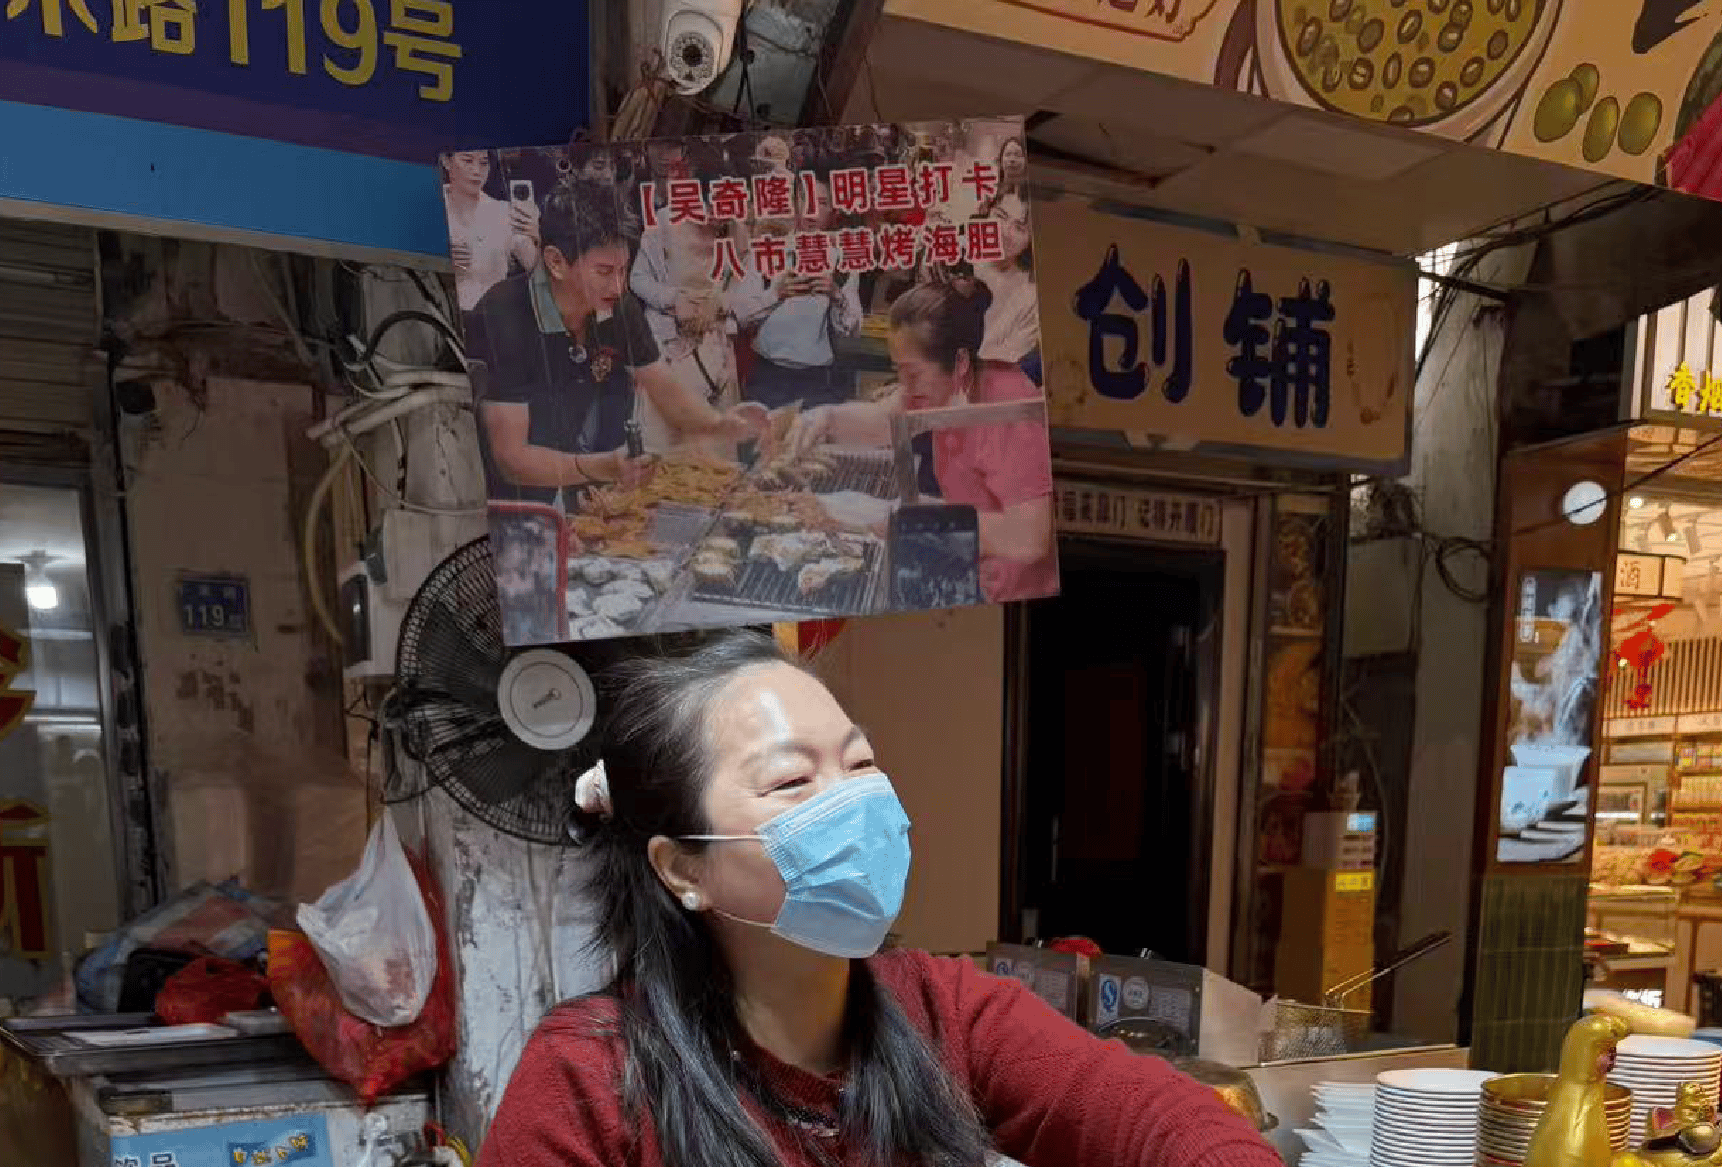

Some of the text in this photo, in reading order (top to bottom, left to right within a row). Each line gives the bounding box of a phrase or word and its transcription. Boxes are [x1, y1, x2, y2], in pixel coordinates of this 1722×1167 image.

[640, 160, 998, 230] 【吴奇隆】明星打卡
[711, 220, 1004, 281] 八市慧慧烤海胆
[1073, 242, 1336, 428] 创铺
